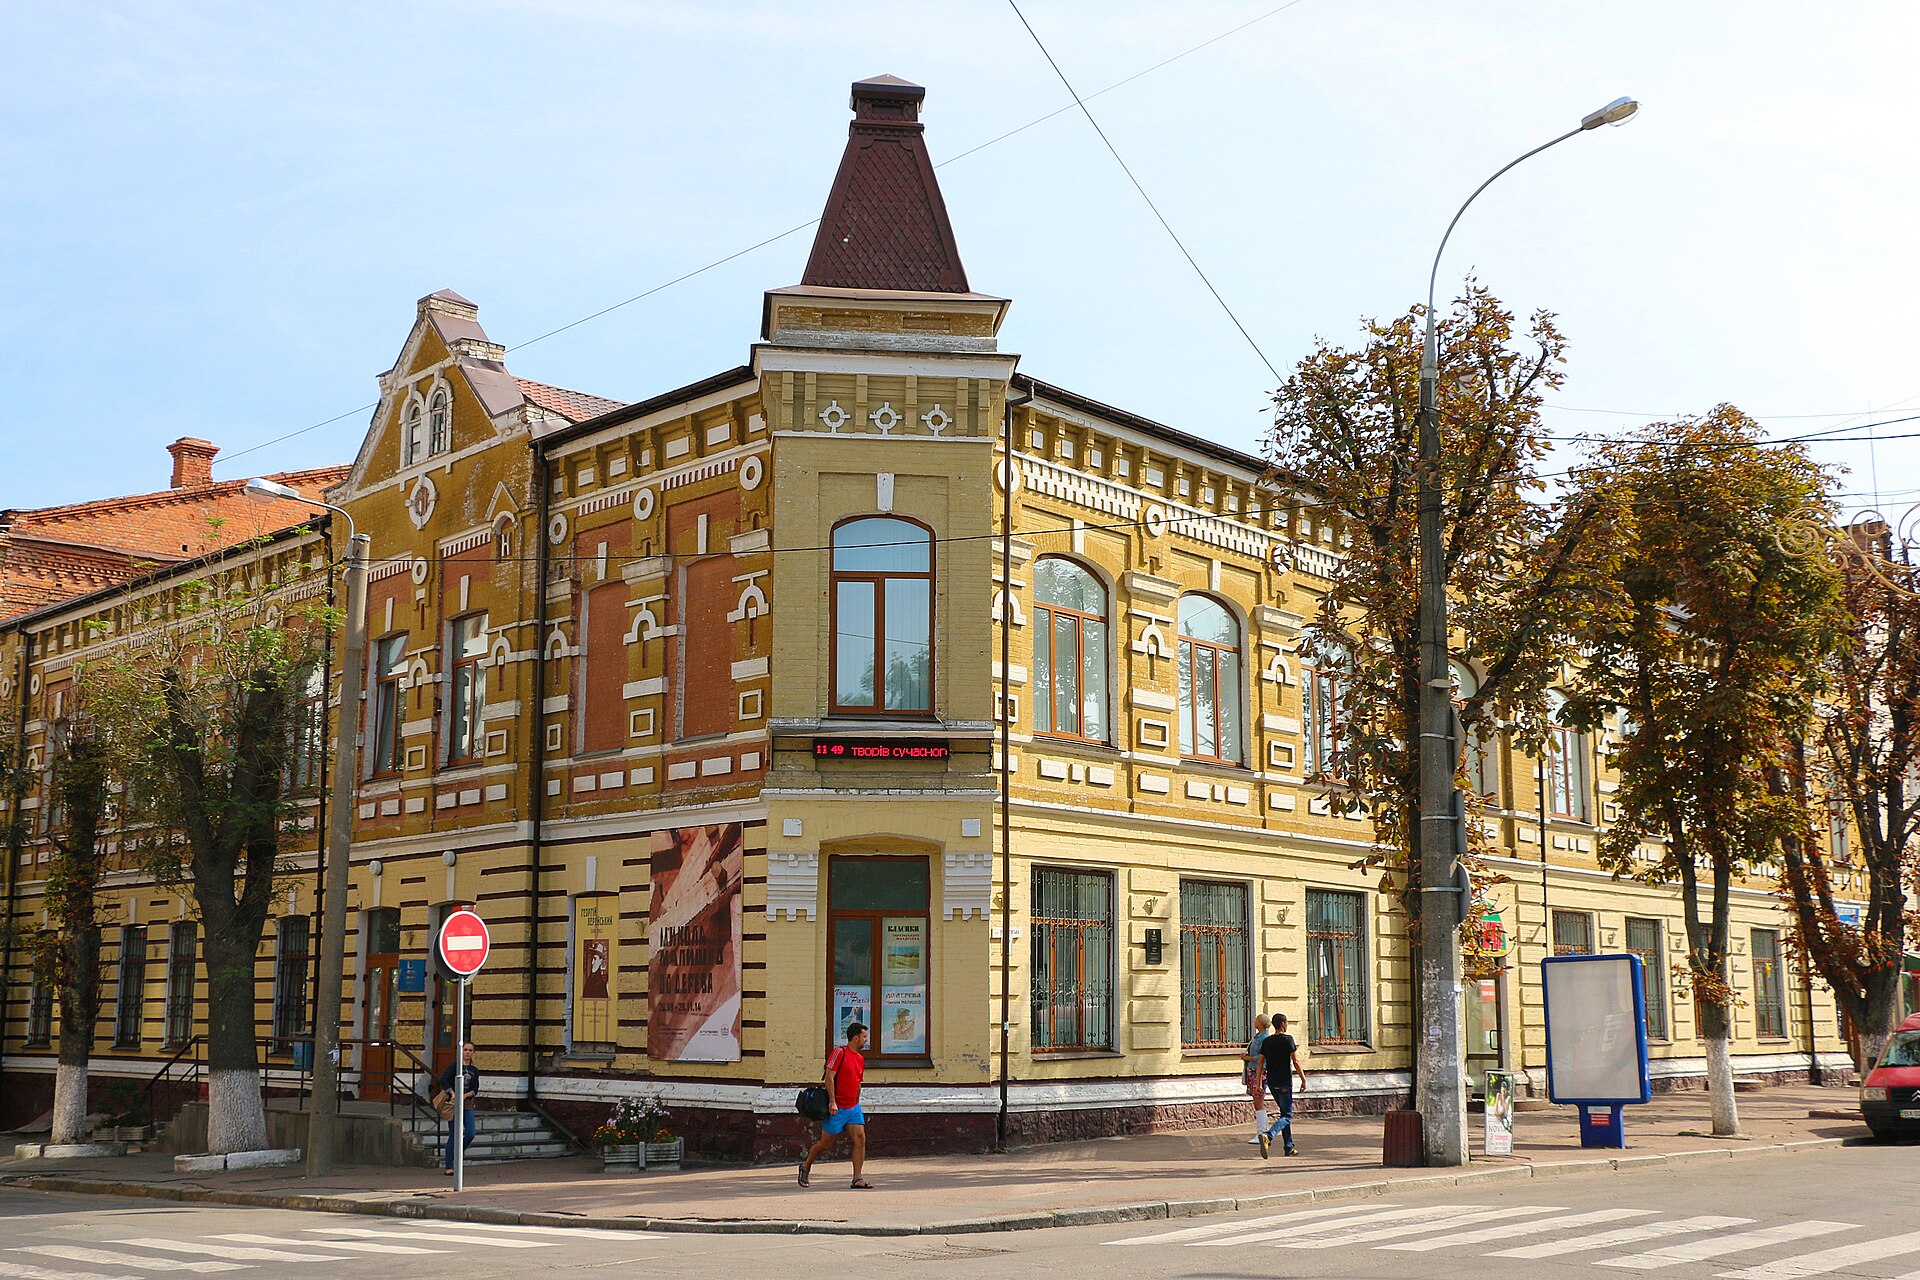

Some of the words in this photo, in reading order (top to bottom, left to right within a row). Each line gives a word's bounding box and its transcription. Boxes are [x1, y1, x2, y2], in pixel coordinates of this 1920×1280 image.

[816, 745, 827, 755] 11
[831, 745, 844, 755] 49
[674, 973, 713, 994] ДЕРЕВА
